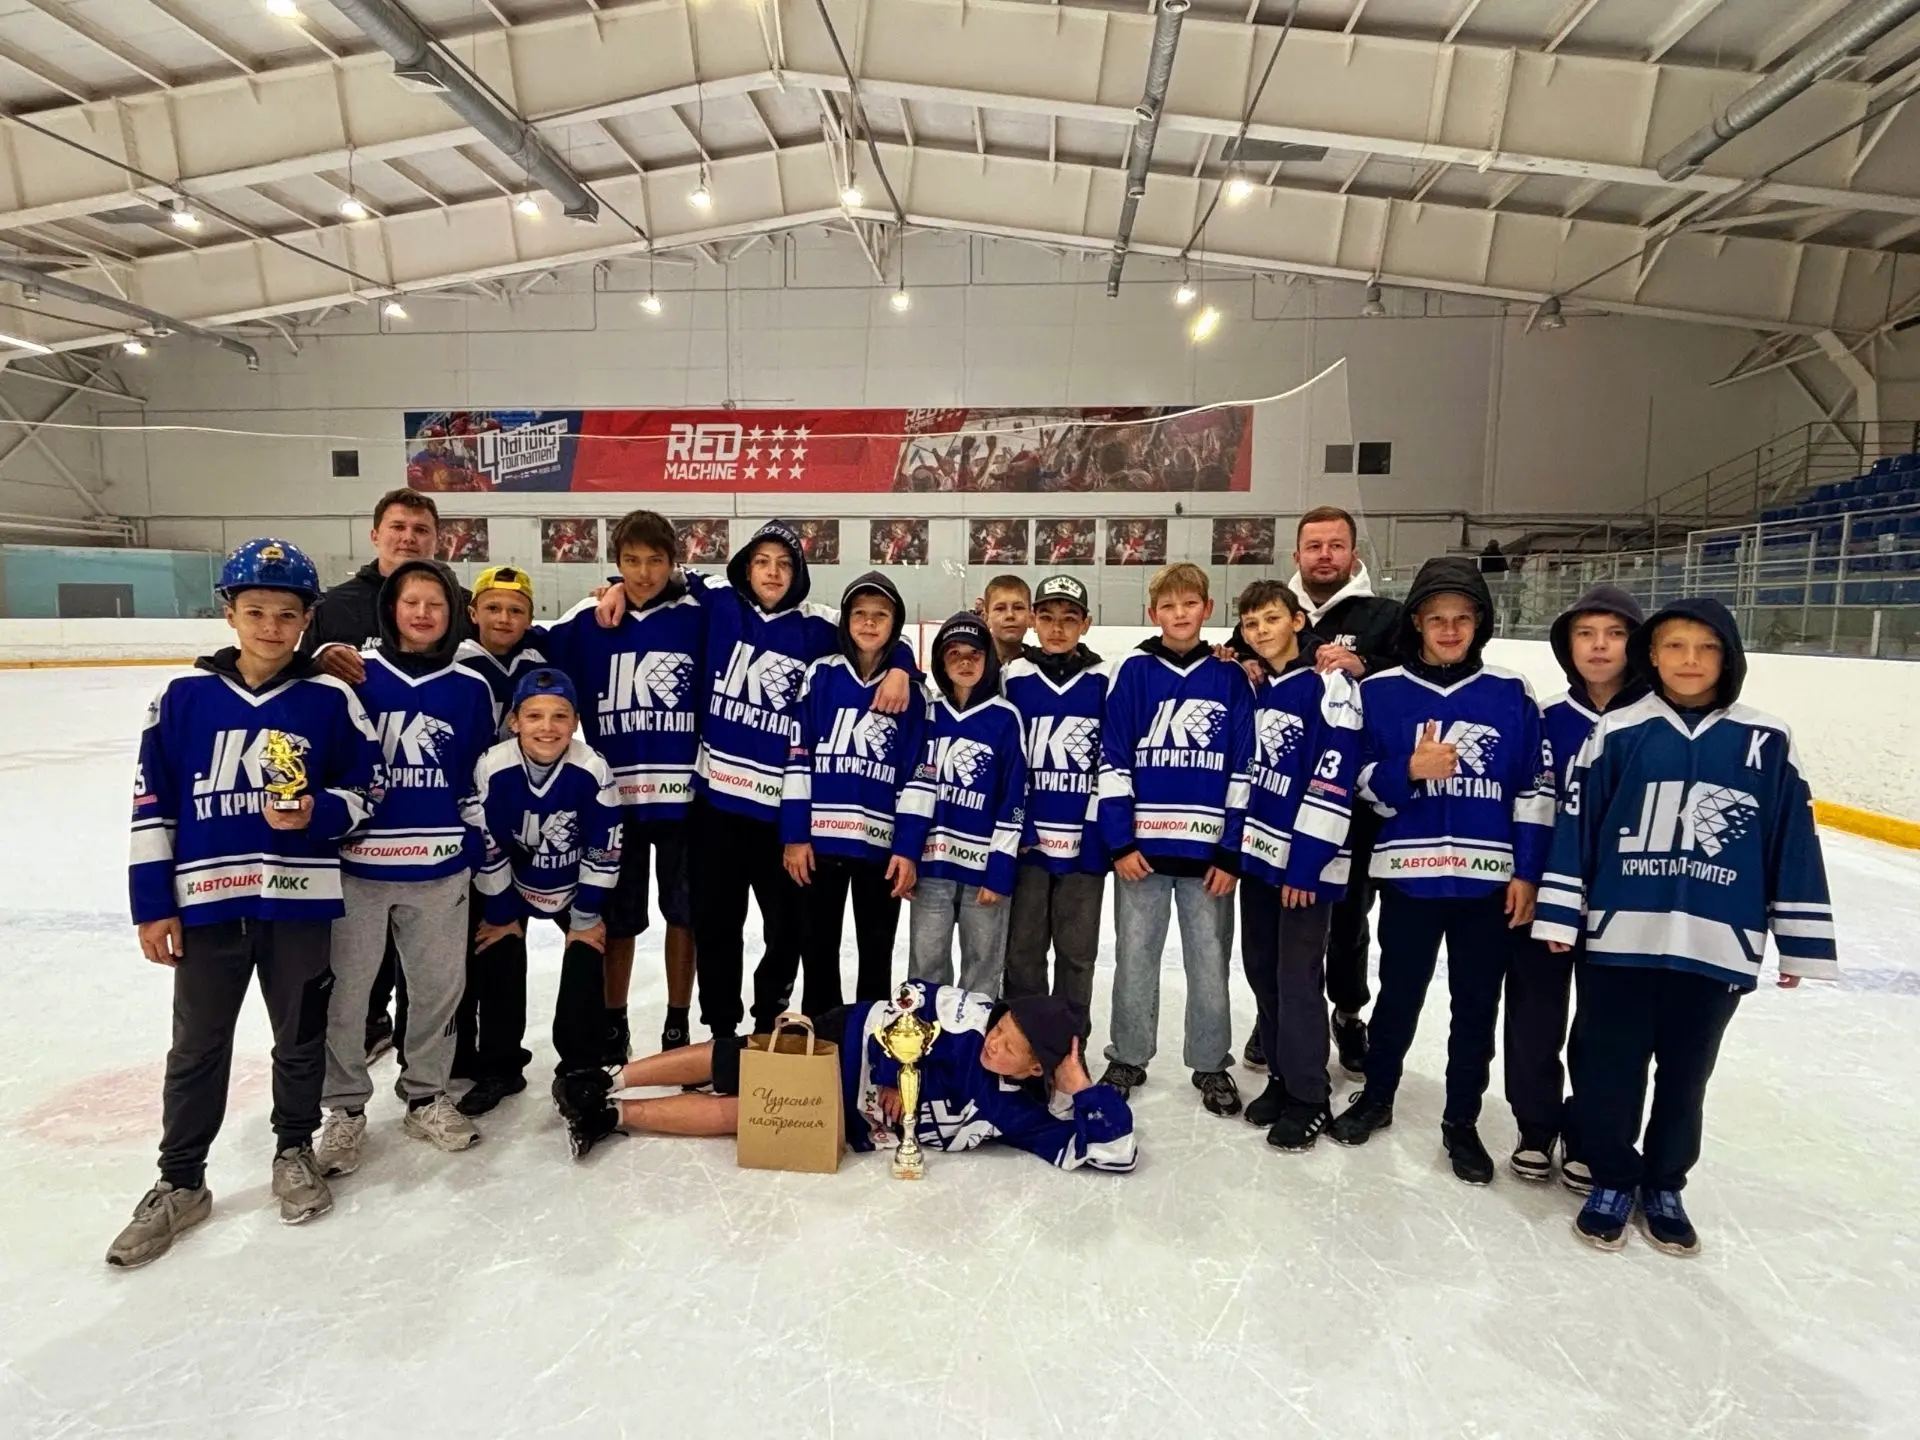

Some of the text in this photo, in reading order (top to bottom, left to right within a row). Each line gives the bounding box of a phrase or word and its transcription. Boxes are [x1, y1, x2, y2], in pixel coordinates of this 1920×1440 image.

[666, 423, 743, 461] RED
[664, 462, 738, 480] MACHINE
[599, 710, 695, 737] ХК КРИСТАЛЛ
[1152, 749, 1225, 771] КРИСТАЛЛ
[1744, 729, 1770, 770] К
[815, 757, 830, 774] ХК
[835, 758, 896, 785] КРИСТАЛЛ
[194, 796, 213, 821] ХК
[949, 845, 987, 864] ЛЮКС
[267, 874, 310, 890] ЛЮКС
[749, 1116, 825, 1135] настроения
